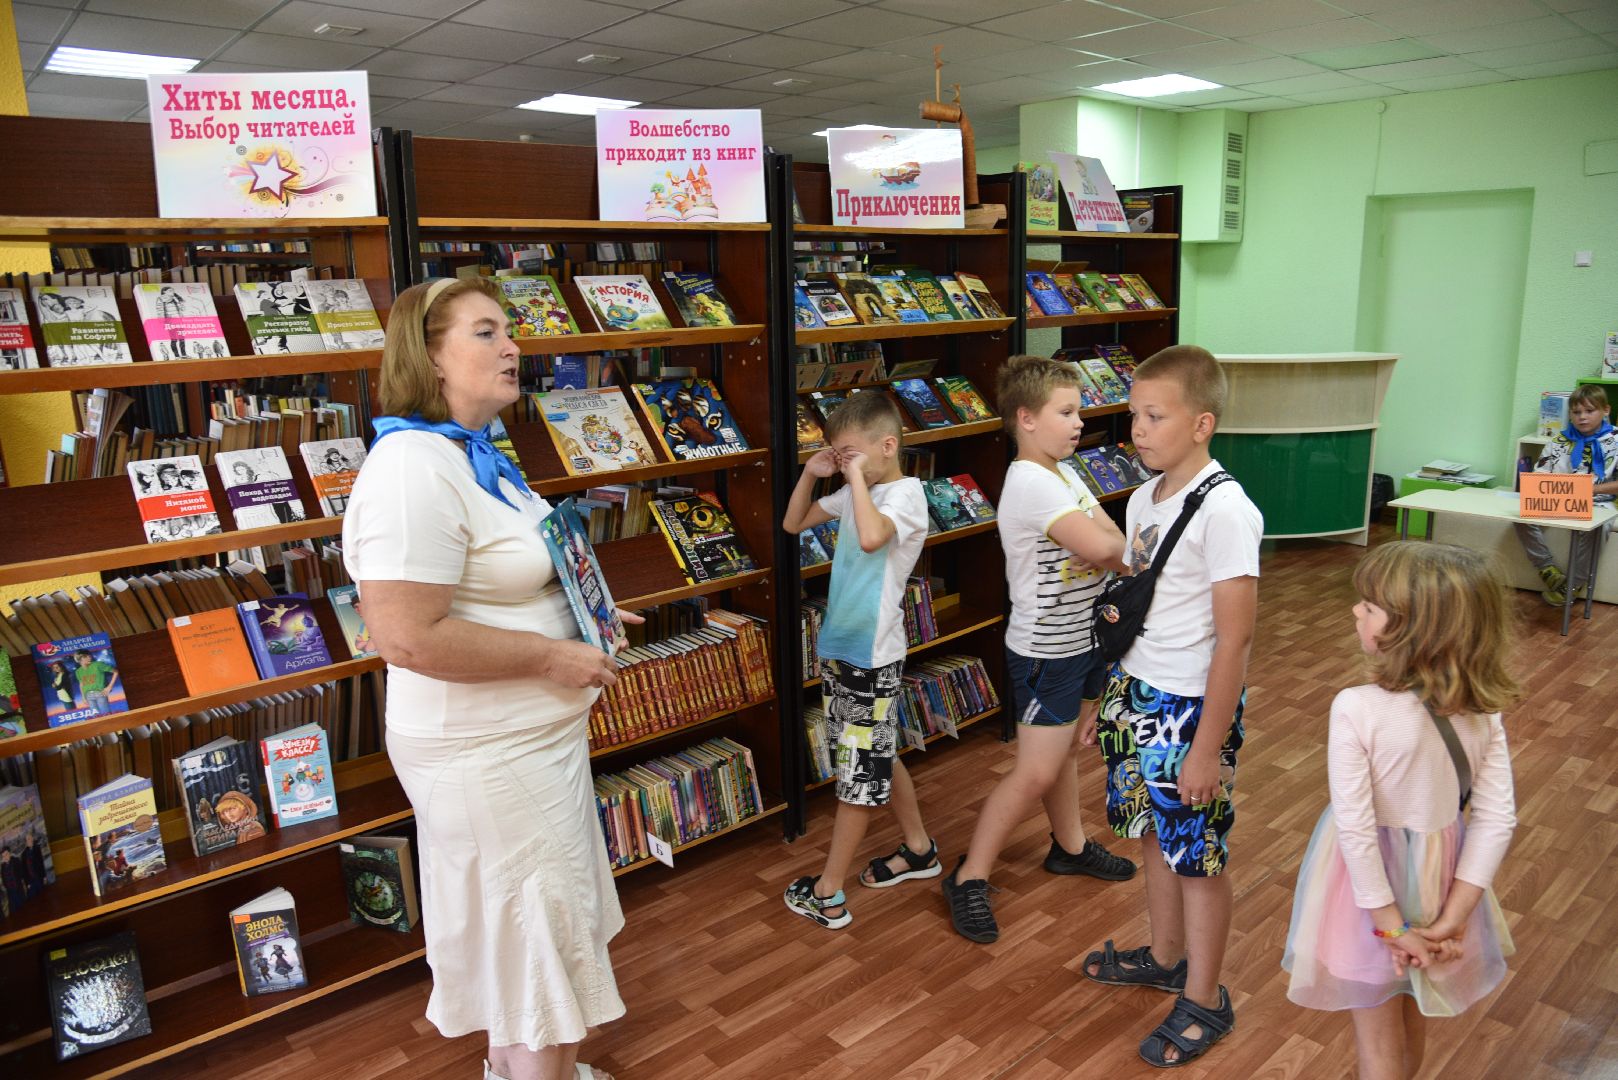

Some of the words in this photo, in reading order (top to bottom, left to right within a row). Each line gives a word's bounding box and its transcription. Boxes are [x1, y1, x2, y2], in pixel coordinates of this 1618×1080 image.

[162, 84, 241, 111] Хиты
[252, 88, 356, 111] месяца.
[169, 116, 240, 144] Выбор
[246, 112, 355, 138] читателей
[629, 119, 730, 137] Волшебство
[606, 147, 687, 165] приходит
[693, 148, 711, 160] из
[717, 147, 757, 160] книг
[836, 188, 961, 225] Приключения
[1067, 191, 1125, 224] Детективы
[596, 285, 650, 303] ИСТОРИЯ
[681, 442, 745, 460] ЖИВОТНЫЕ
[1538, 481, 1574, 495] СТИХИ
[1525, 497, 1560, 513] ПИШУ
[1565, 498, 1589, 513] САМ
[285, 655, 326, 670] Ариэль
[57, 708, 100, 723] ЗВЕЗДА
[246, 915, 283, 932] ЭНОЛА
[247, 923, 285, 941] ХОЛМС
